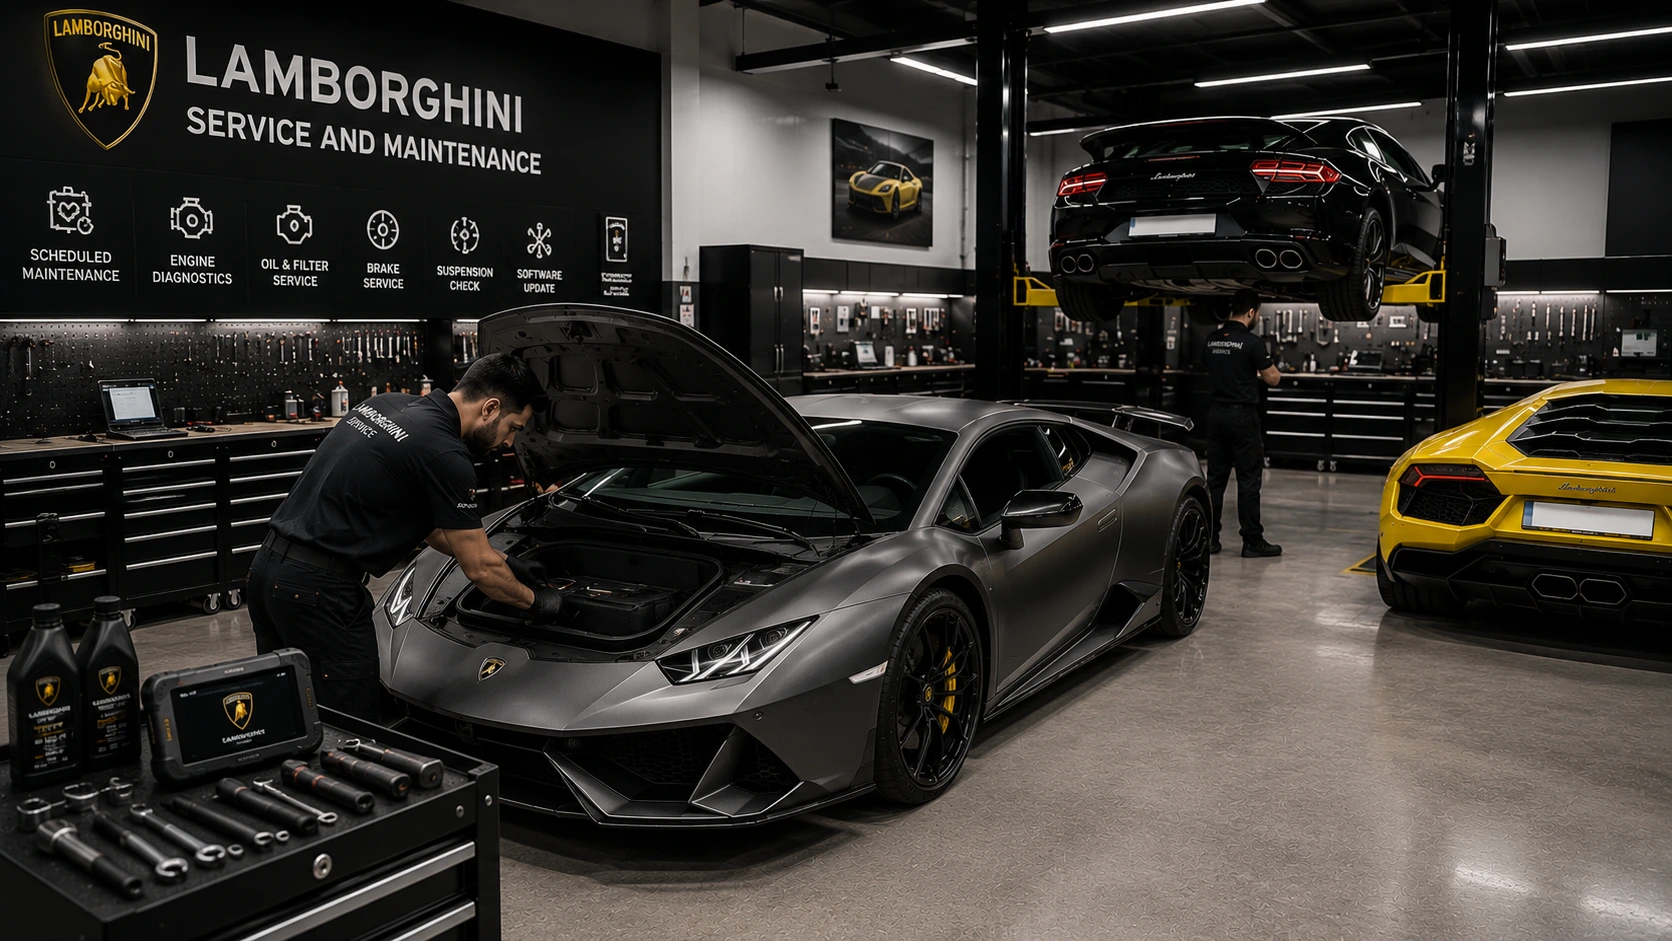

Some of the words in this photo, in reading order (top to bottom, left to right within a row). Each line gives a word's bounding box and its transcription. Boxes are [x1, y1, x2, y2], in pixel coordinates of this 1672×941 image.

[53, 18, 150, 52] LAMBORGHINI
[186, 35, 523, 133] LAMBORGHINI
[186, 106, 312, 148] SERVICE
[319, 125, 376, 155] AND
[383, 132, 542, 175] MAINTENANCE
[30, 248, 112, 264] SCHEDULED
[170, 254, 216, 268] ENGINE
[260, 258, 280, 271] OIL
[281, 259, 291, 271] &
[293, 259, 329, 272] FILTER
[366, 262, 400, 275] BRAKE
[436, 265, 494, 278] SUSPENSION
[22, 266, 120, 282] MAINTENANCE
[152, 271, 233, 285] DIAGNOSTICS
[272, 275, 318, 287] SERVICE
[516, 268, 563, 281] SOFTWARE
[363, 277, 404, 290] SERVICE
[449, 280, 480, 292] CHECK
[523, 282, 556, 294] UPDATE
